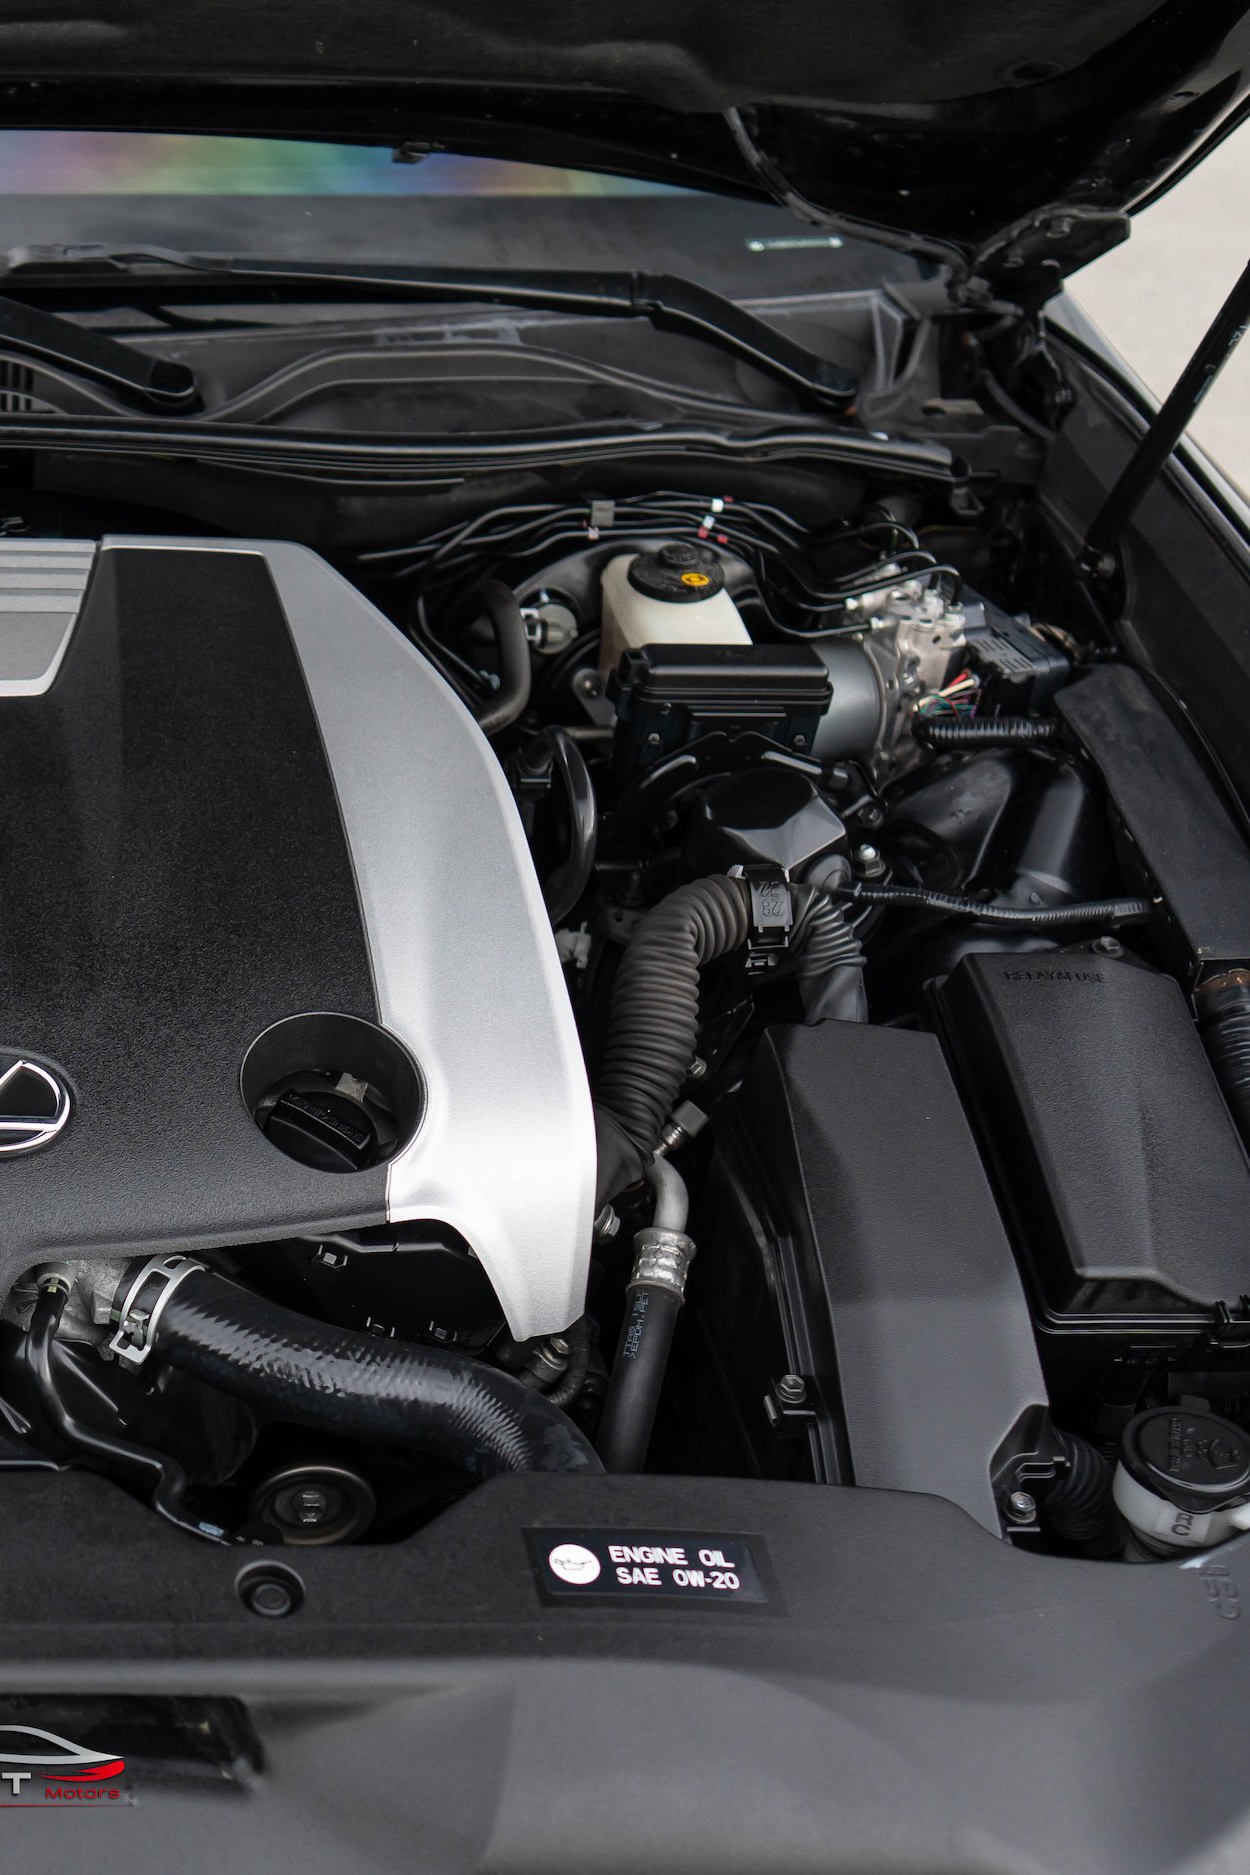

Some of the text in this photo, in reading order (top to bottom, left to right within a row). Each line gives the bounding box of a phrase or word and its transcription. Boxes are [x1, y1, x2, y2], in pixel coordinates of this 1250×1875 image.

[608, 1545, 736, 1568] ENGINE OIL
[615, 1567, 740, 1590] SAE 0W-20
